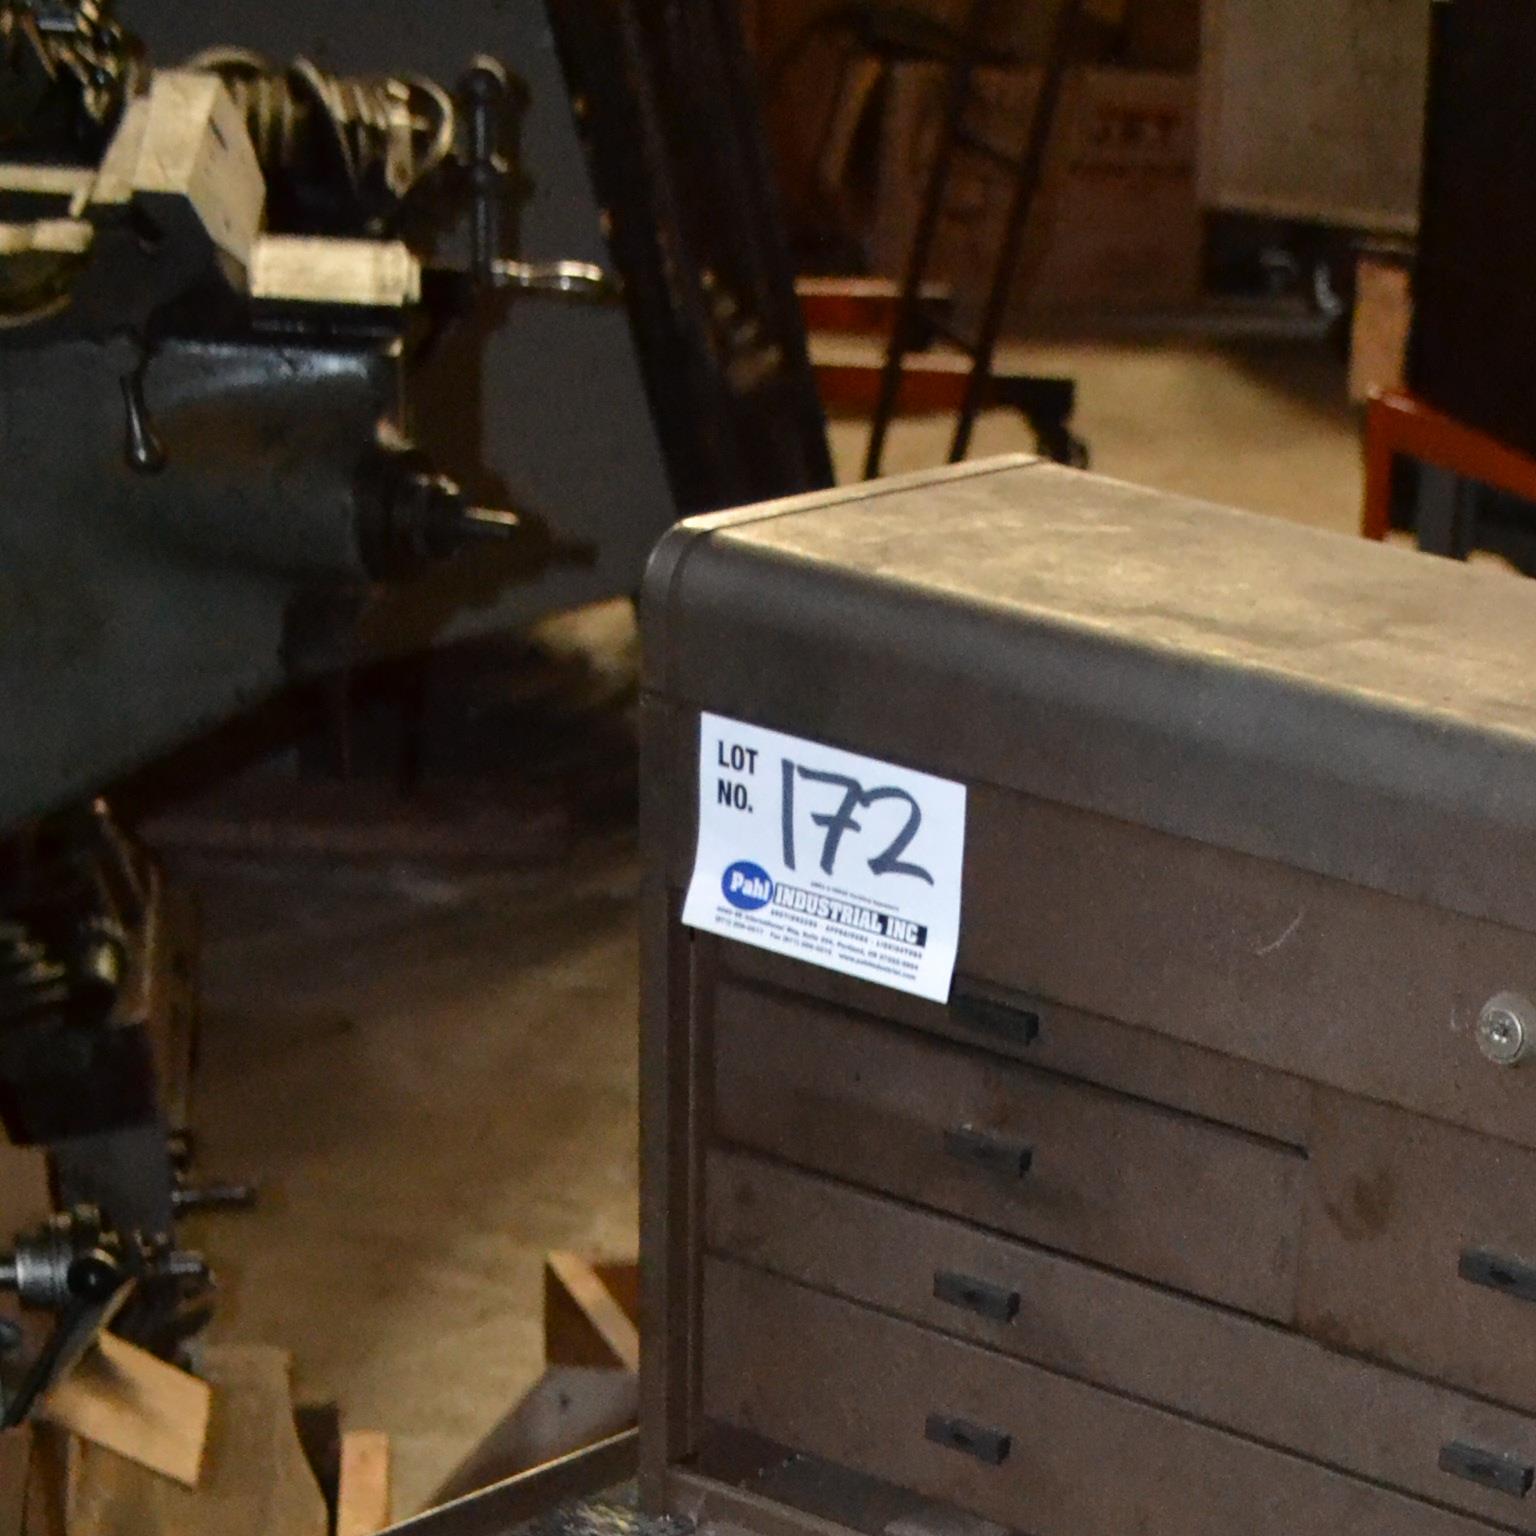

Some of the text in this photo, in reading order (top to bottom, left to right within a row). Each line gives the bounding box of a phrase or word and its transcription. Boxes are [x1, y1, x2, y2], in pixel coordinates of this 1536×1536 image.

[716, 740, 758, 775] LOT
[717, 777, 754, 813] NO.
[780, 758, 935, 887] 172
[730, 870, 770, 901] Pahl
[773, 884, 882, 936] INDUSTRIAL
[886, 916, 918, 946] INC
